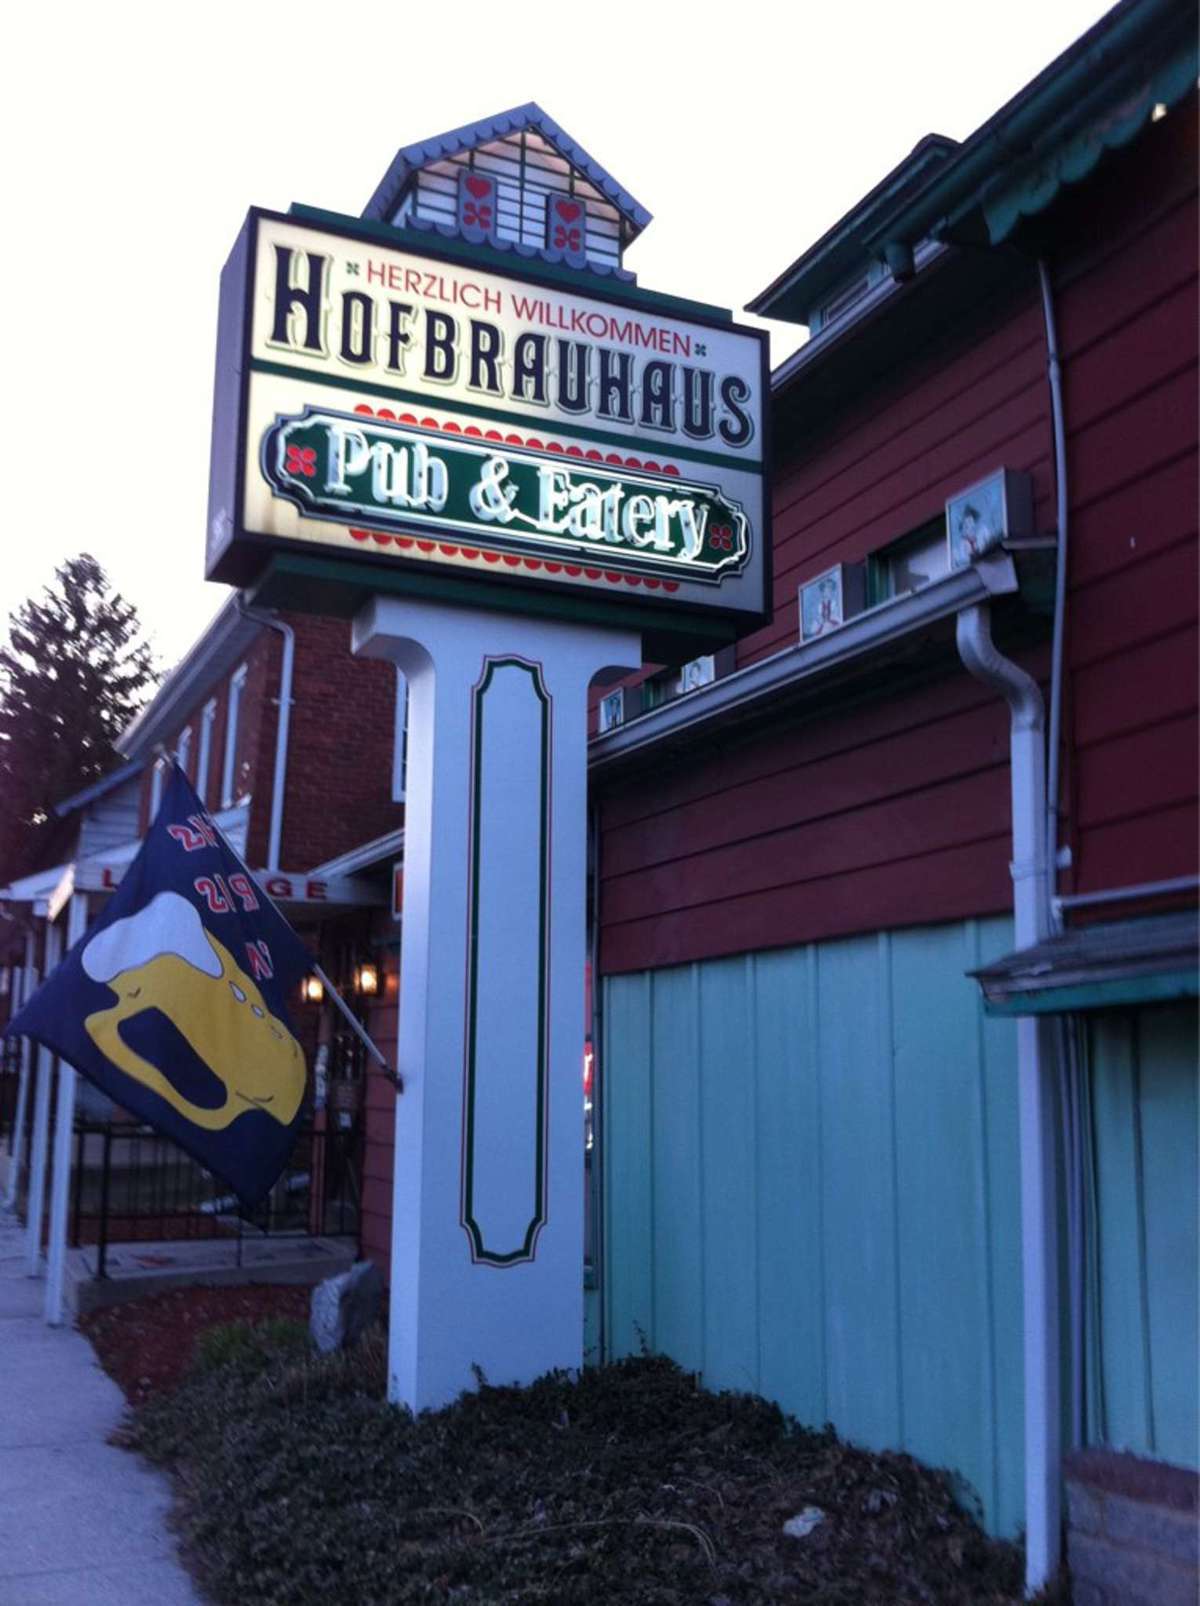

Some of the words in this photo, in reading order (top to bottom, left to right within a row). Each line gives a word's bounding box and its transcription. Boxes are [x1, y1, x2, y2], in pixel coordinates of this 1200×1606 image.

[266, 244, 753, 447] HOFBRAUHAUS
[367, 260, 502, 314] HERZLICH
[511, 294, 691, 357] WILLKOMMEN
[324, 426, 449, 511] Pub
[469, 457, 521, 523] &
[535, 466, 711, 561] Eatery
